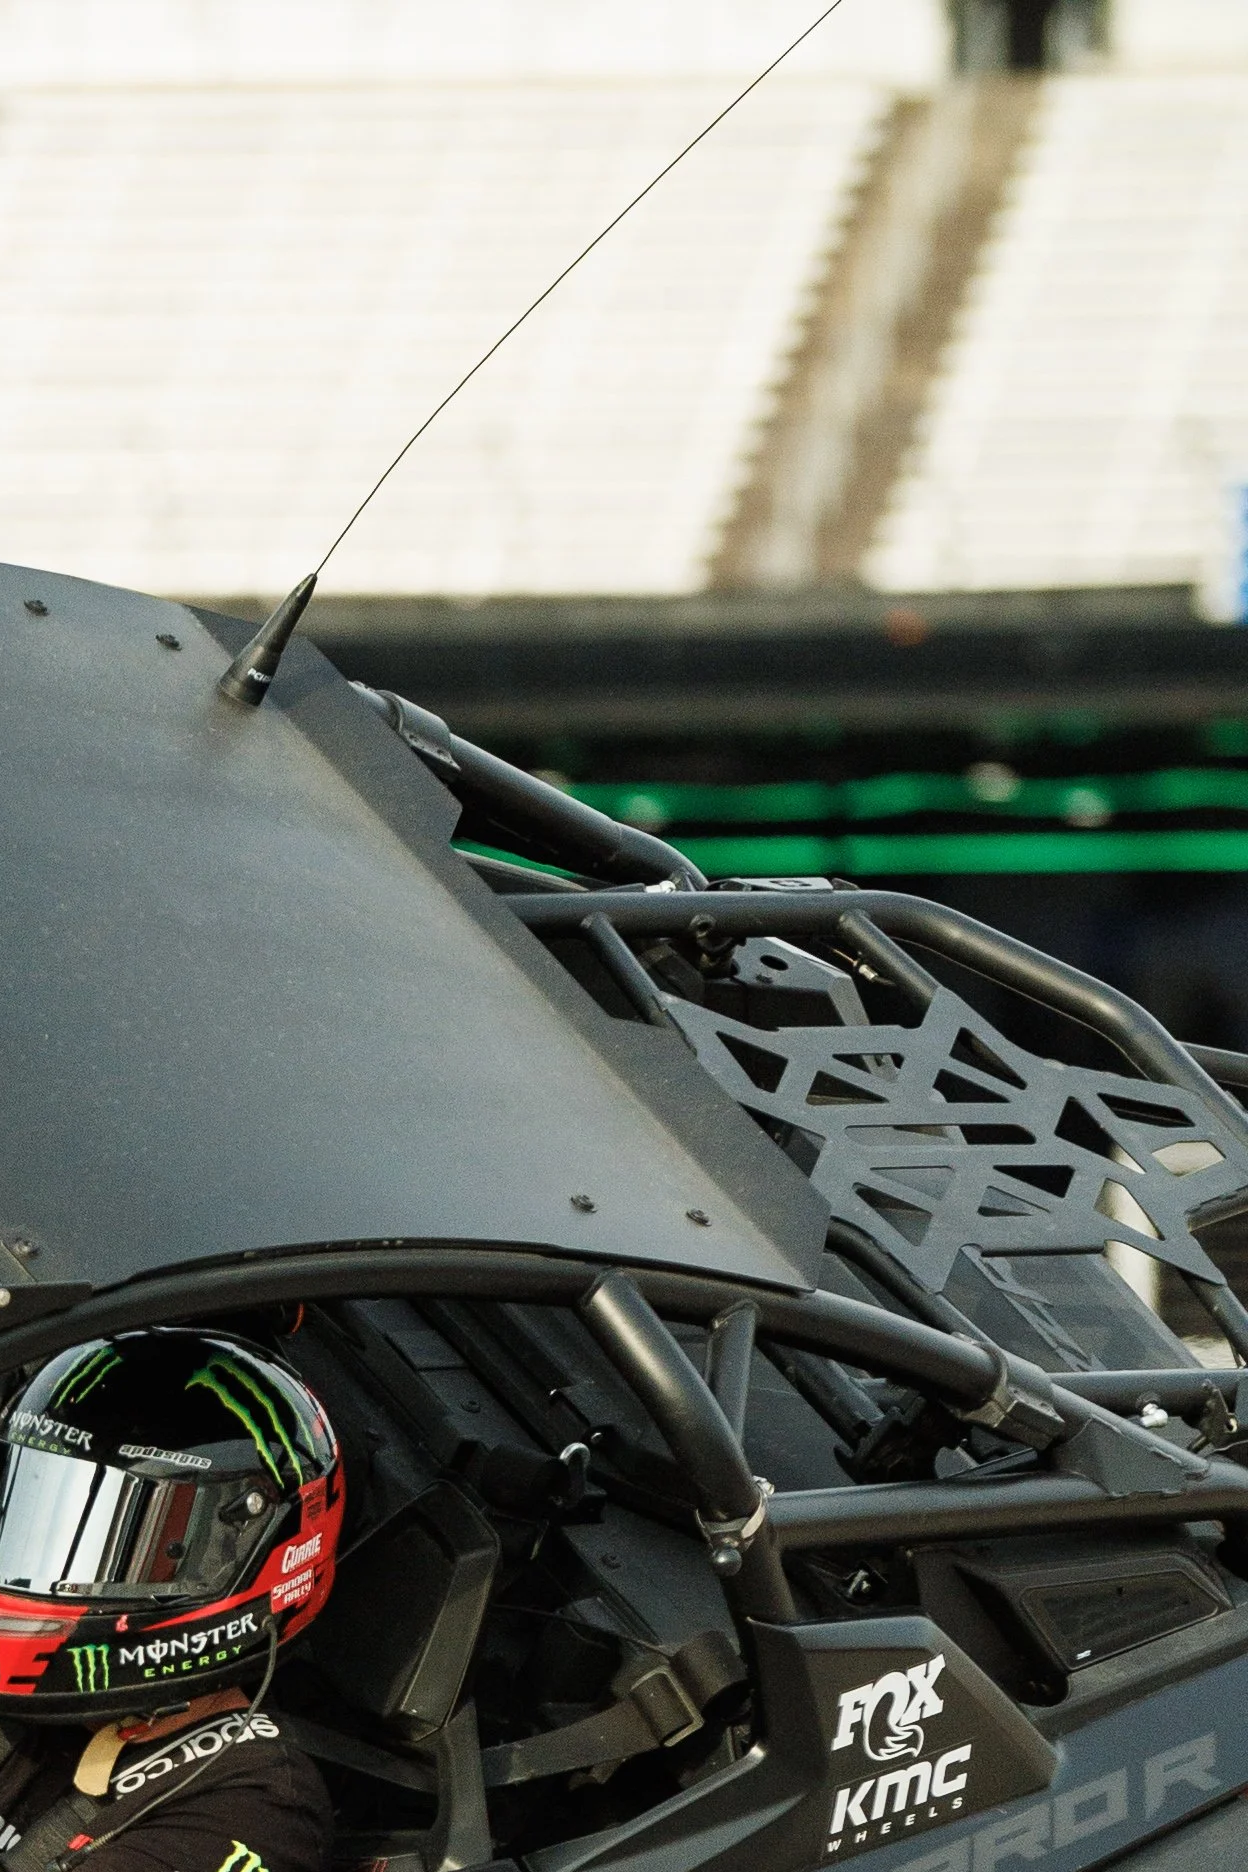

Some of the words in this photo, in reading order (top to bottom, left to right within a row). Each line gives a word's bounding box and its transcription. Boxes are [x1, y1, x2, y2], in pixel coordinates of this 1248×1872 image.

[119, 1612, 258, 1666] MONSTER
[144, 1645, 242, 1678] ENERGY
[831, 1653, 946, 1761] FOX
[1144, 1732, 1223, 1819] R
[827, 1797, 963, 1853] WHEELS
